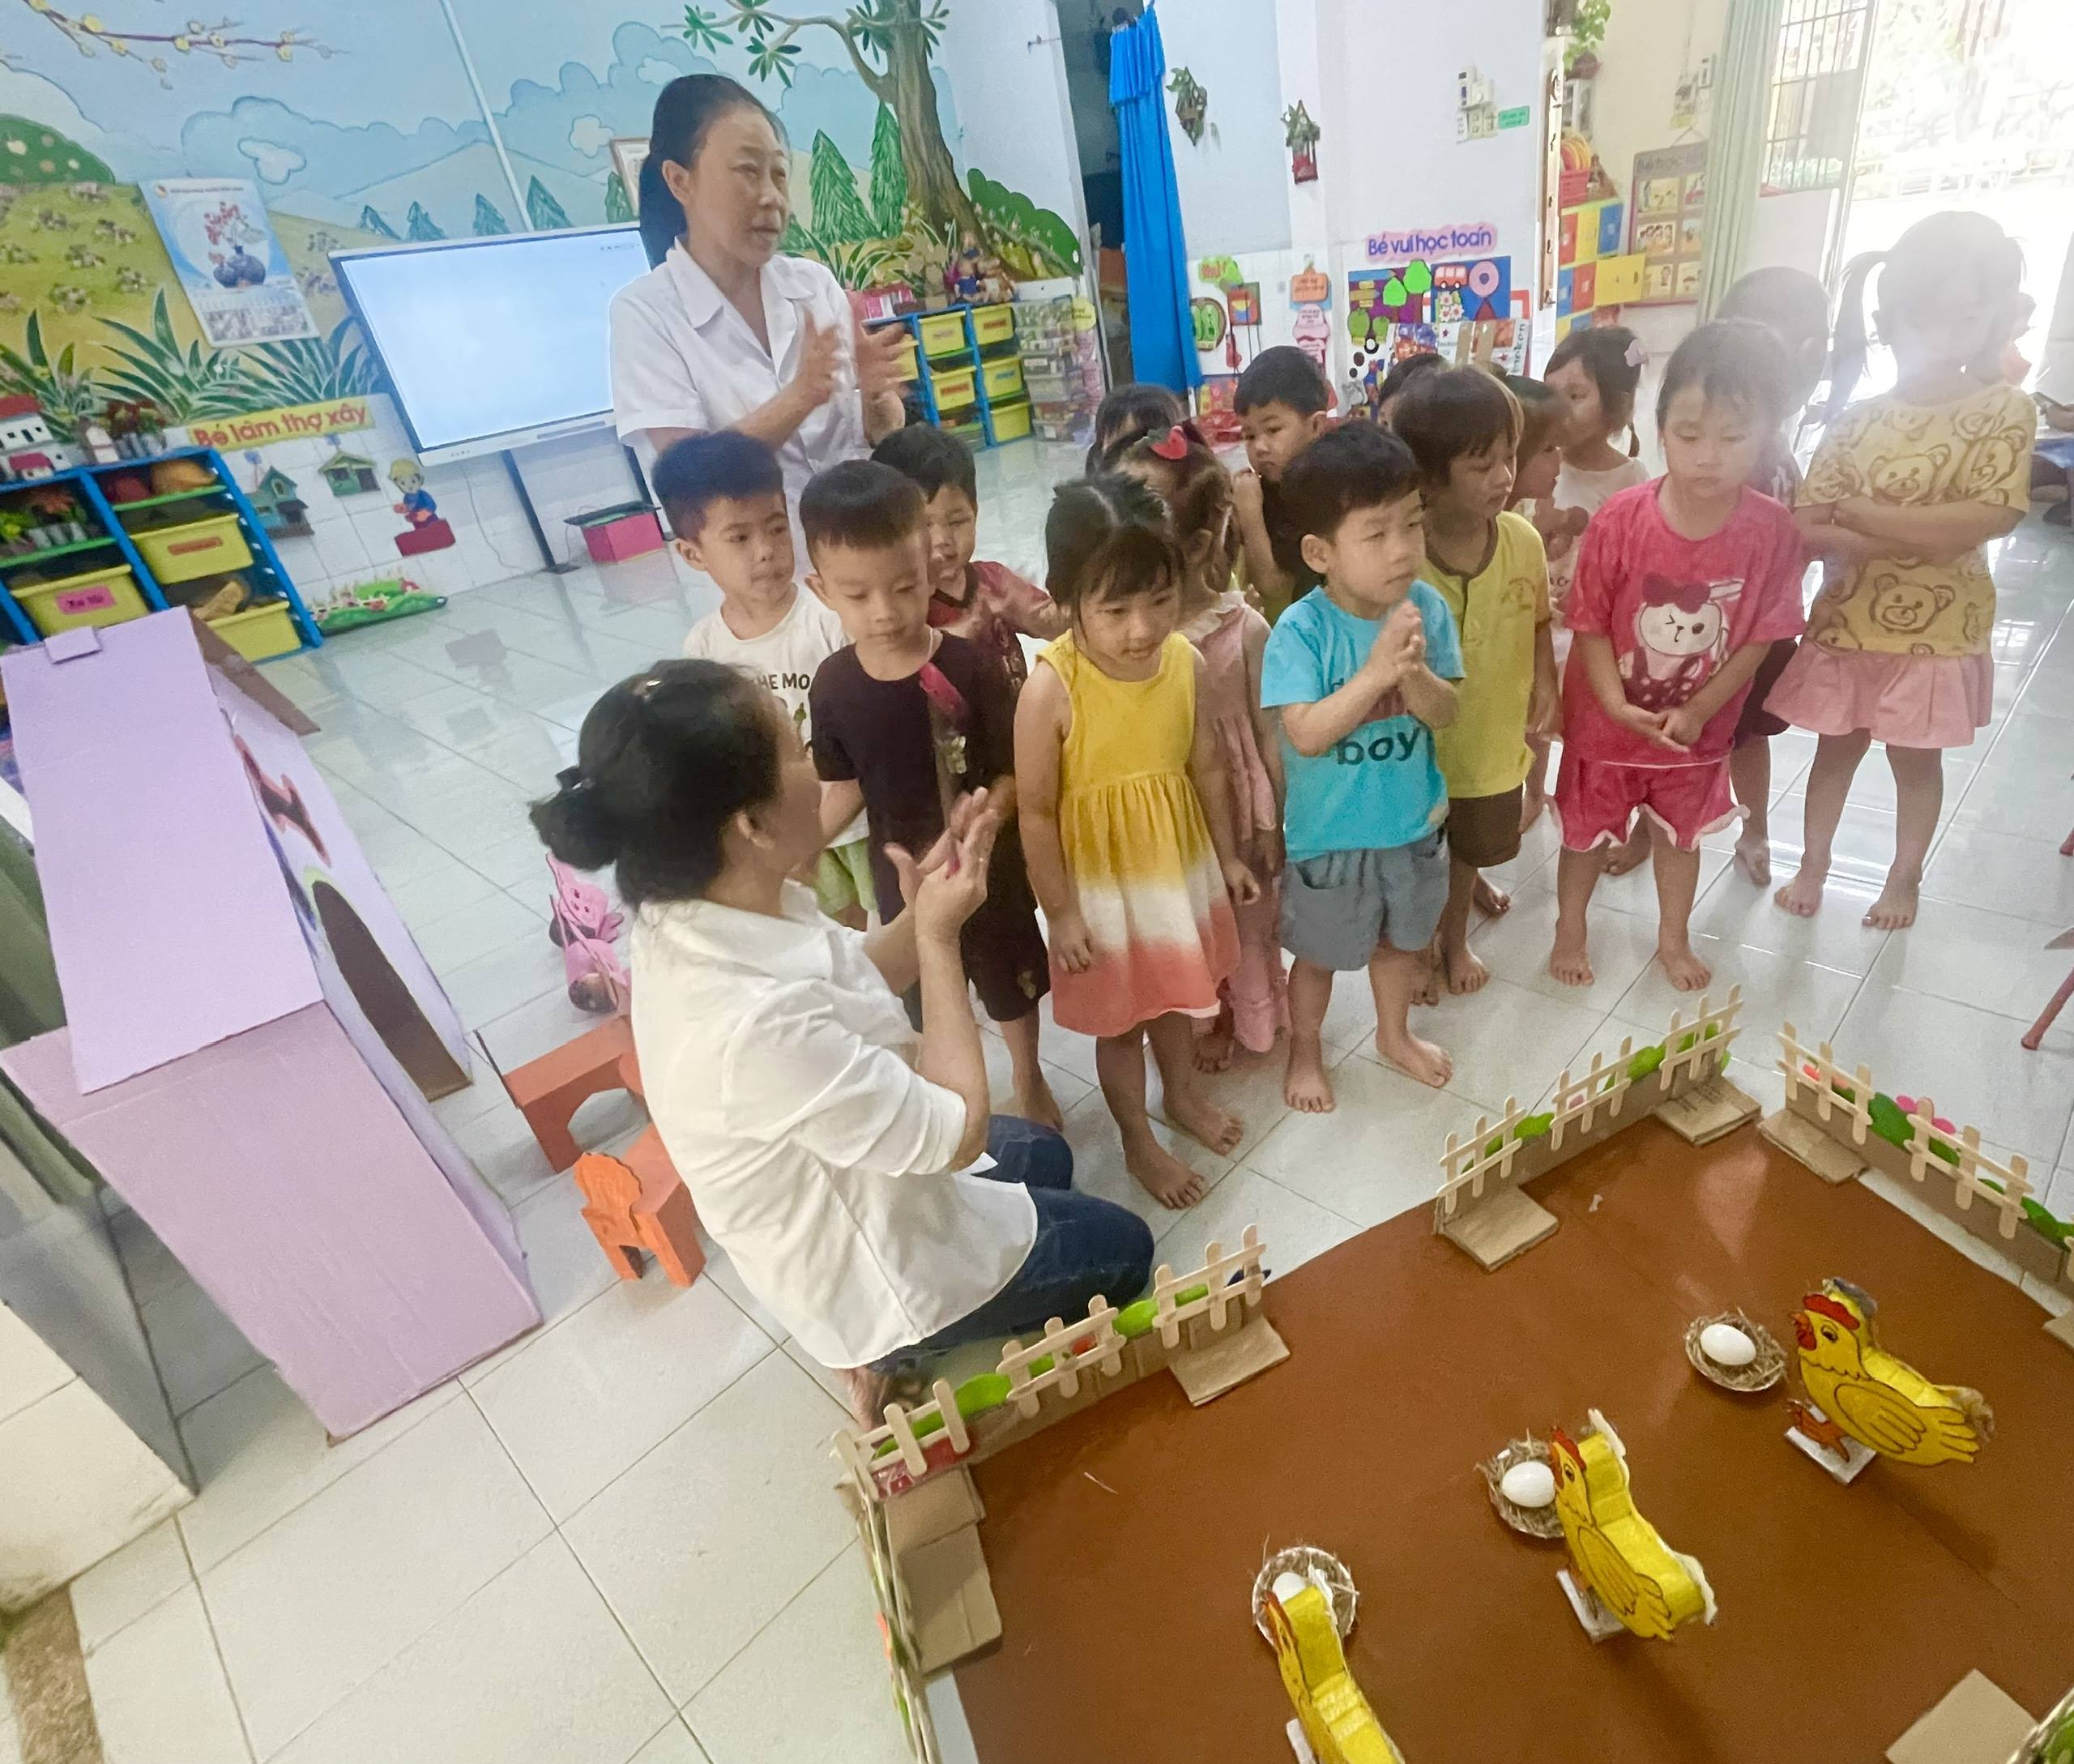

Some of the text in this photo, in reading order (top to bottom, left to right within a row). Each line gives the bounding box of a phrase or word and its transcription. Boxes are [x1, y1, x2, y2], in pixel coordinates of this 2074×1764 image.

[1368, 233, 1388, 255] Bé
[1415, 234, 1449, 255] học
[1451, 226, 1491, 248] toán
[194, 424, 228, 447] Bé
[280, 412, 322, 432] thợ
[326, 403, 365, 425] xây
[1337, 728, 1419, 766] boy
